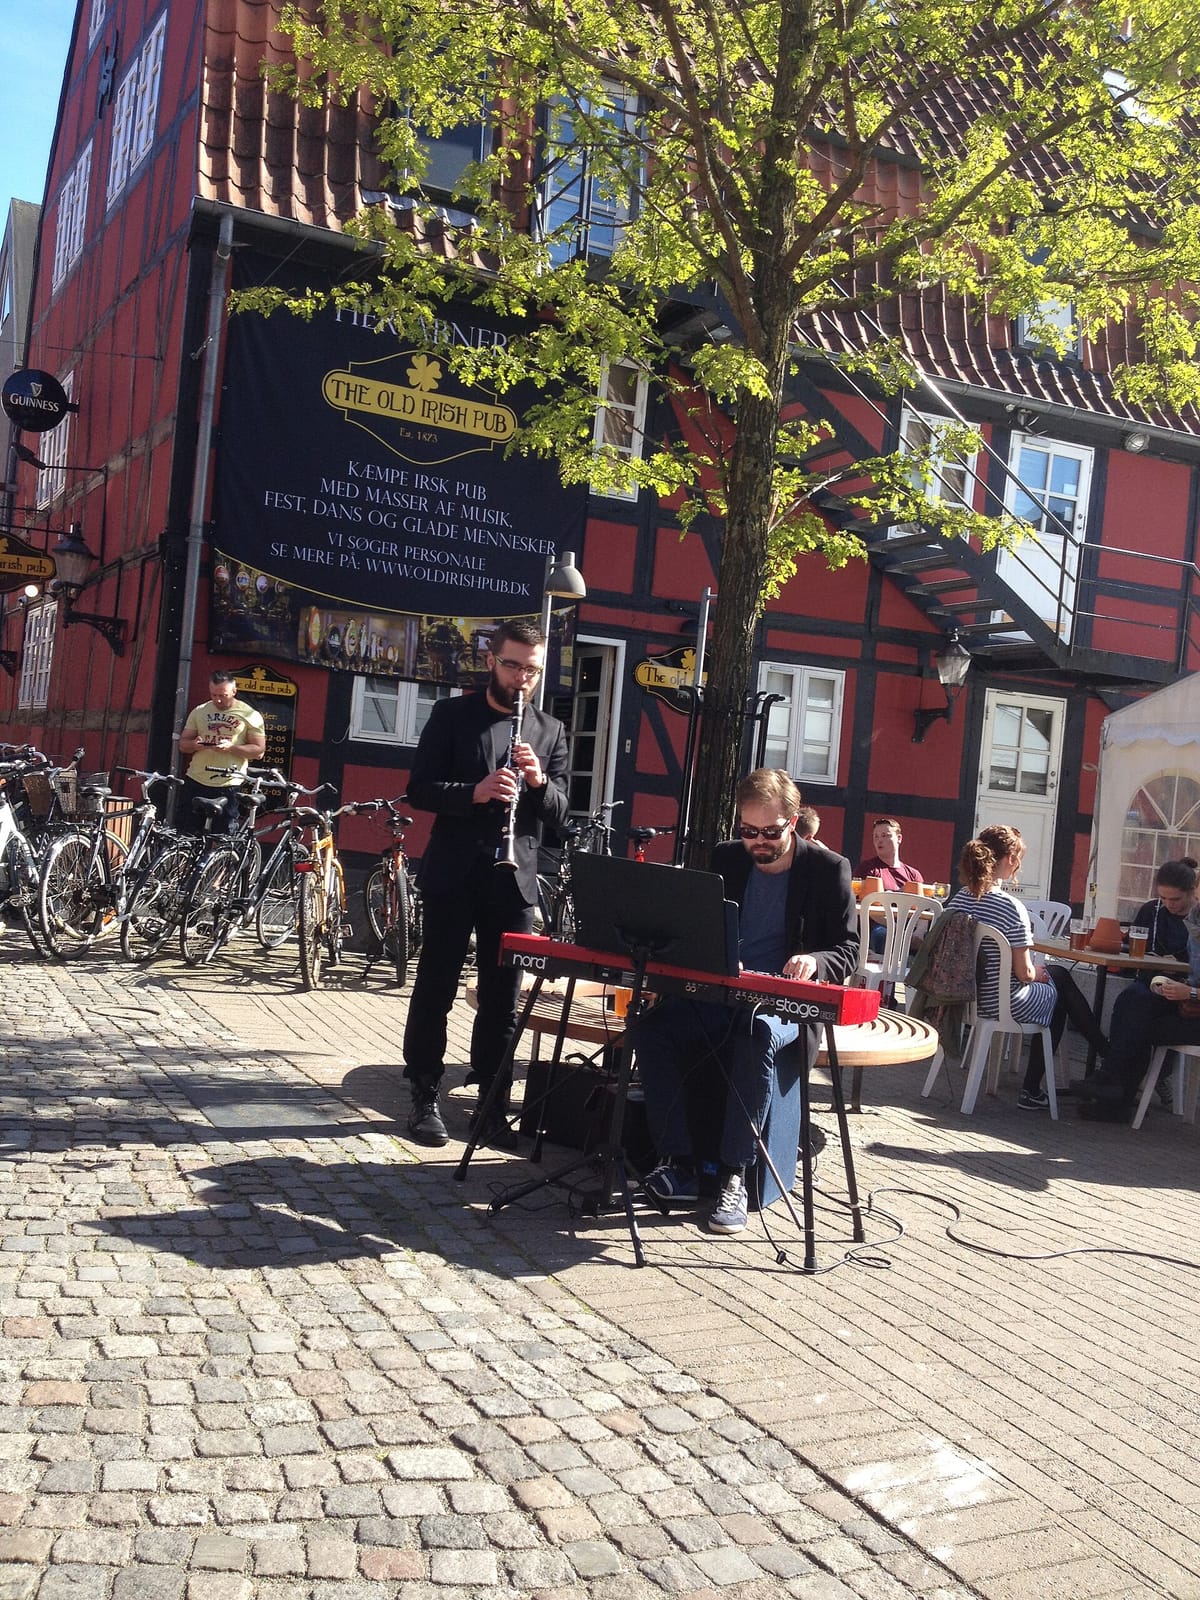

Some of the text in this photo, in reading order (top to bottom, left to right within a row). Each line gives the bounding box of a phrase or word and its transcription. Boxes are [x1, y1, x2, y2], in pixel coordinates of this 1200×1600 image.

[10, 393, 60, 412] GUINNESS
[332, 379, 507, 433] THE OLD IRISH PUB
[348, 460, 487, 501] KÆMPE IRSK PUB
[320, 478, 359, 499] MED
[366, 486, 429, 513] MASSER
[435, 500, 455, 516] AF
[264, 491, 556, 555] FEST, DANS OG GLADE MENNESKER
[328, 532, 487, 571] VI SØGER PERSONALE
[26, 560, 47, 573] pub
[270, 542, 288, 557] SE
[293, 546, 334, 566] MERE
[366, 558, 530, 596] WWW.OLDIRISHPUB.DK
[245, 680, 257, 690] old
[277, 685, 291, 695] pub
[645, 666, 687, 685] The old
[513, 953, 546, 970] nord
[776, 998, 819, 1018] stage
